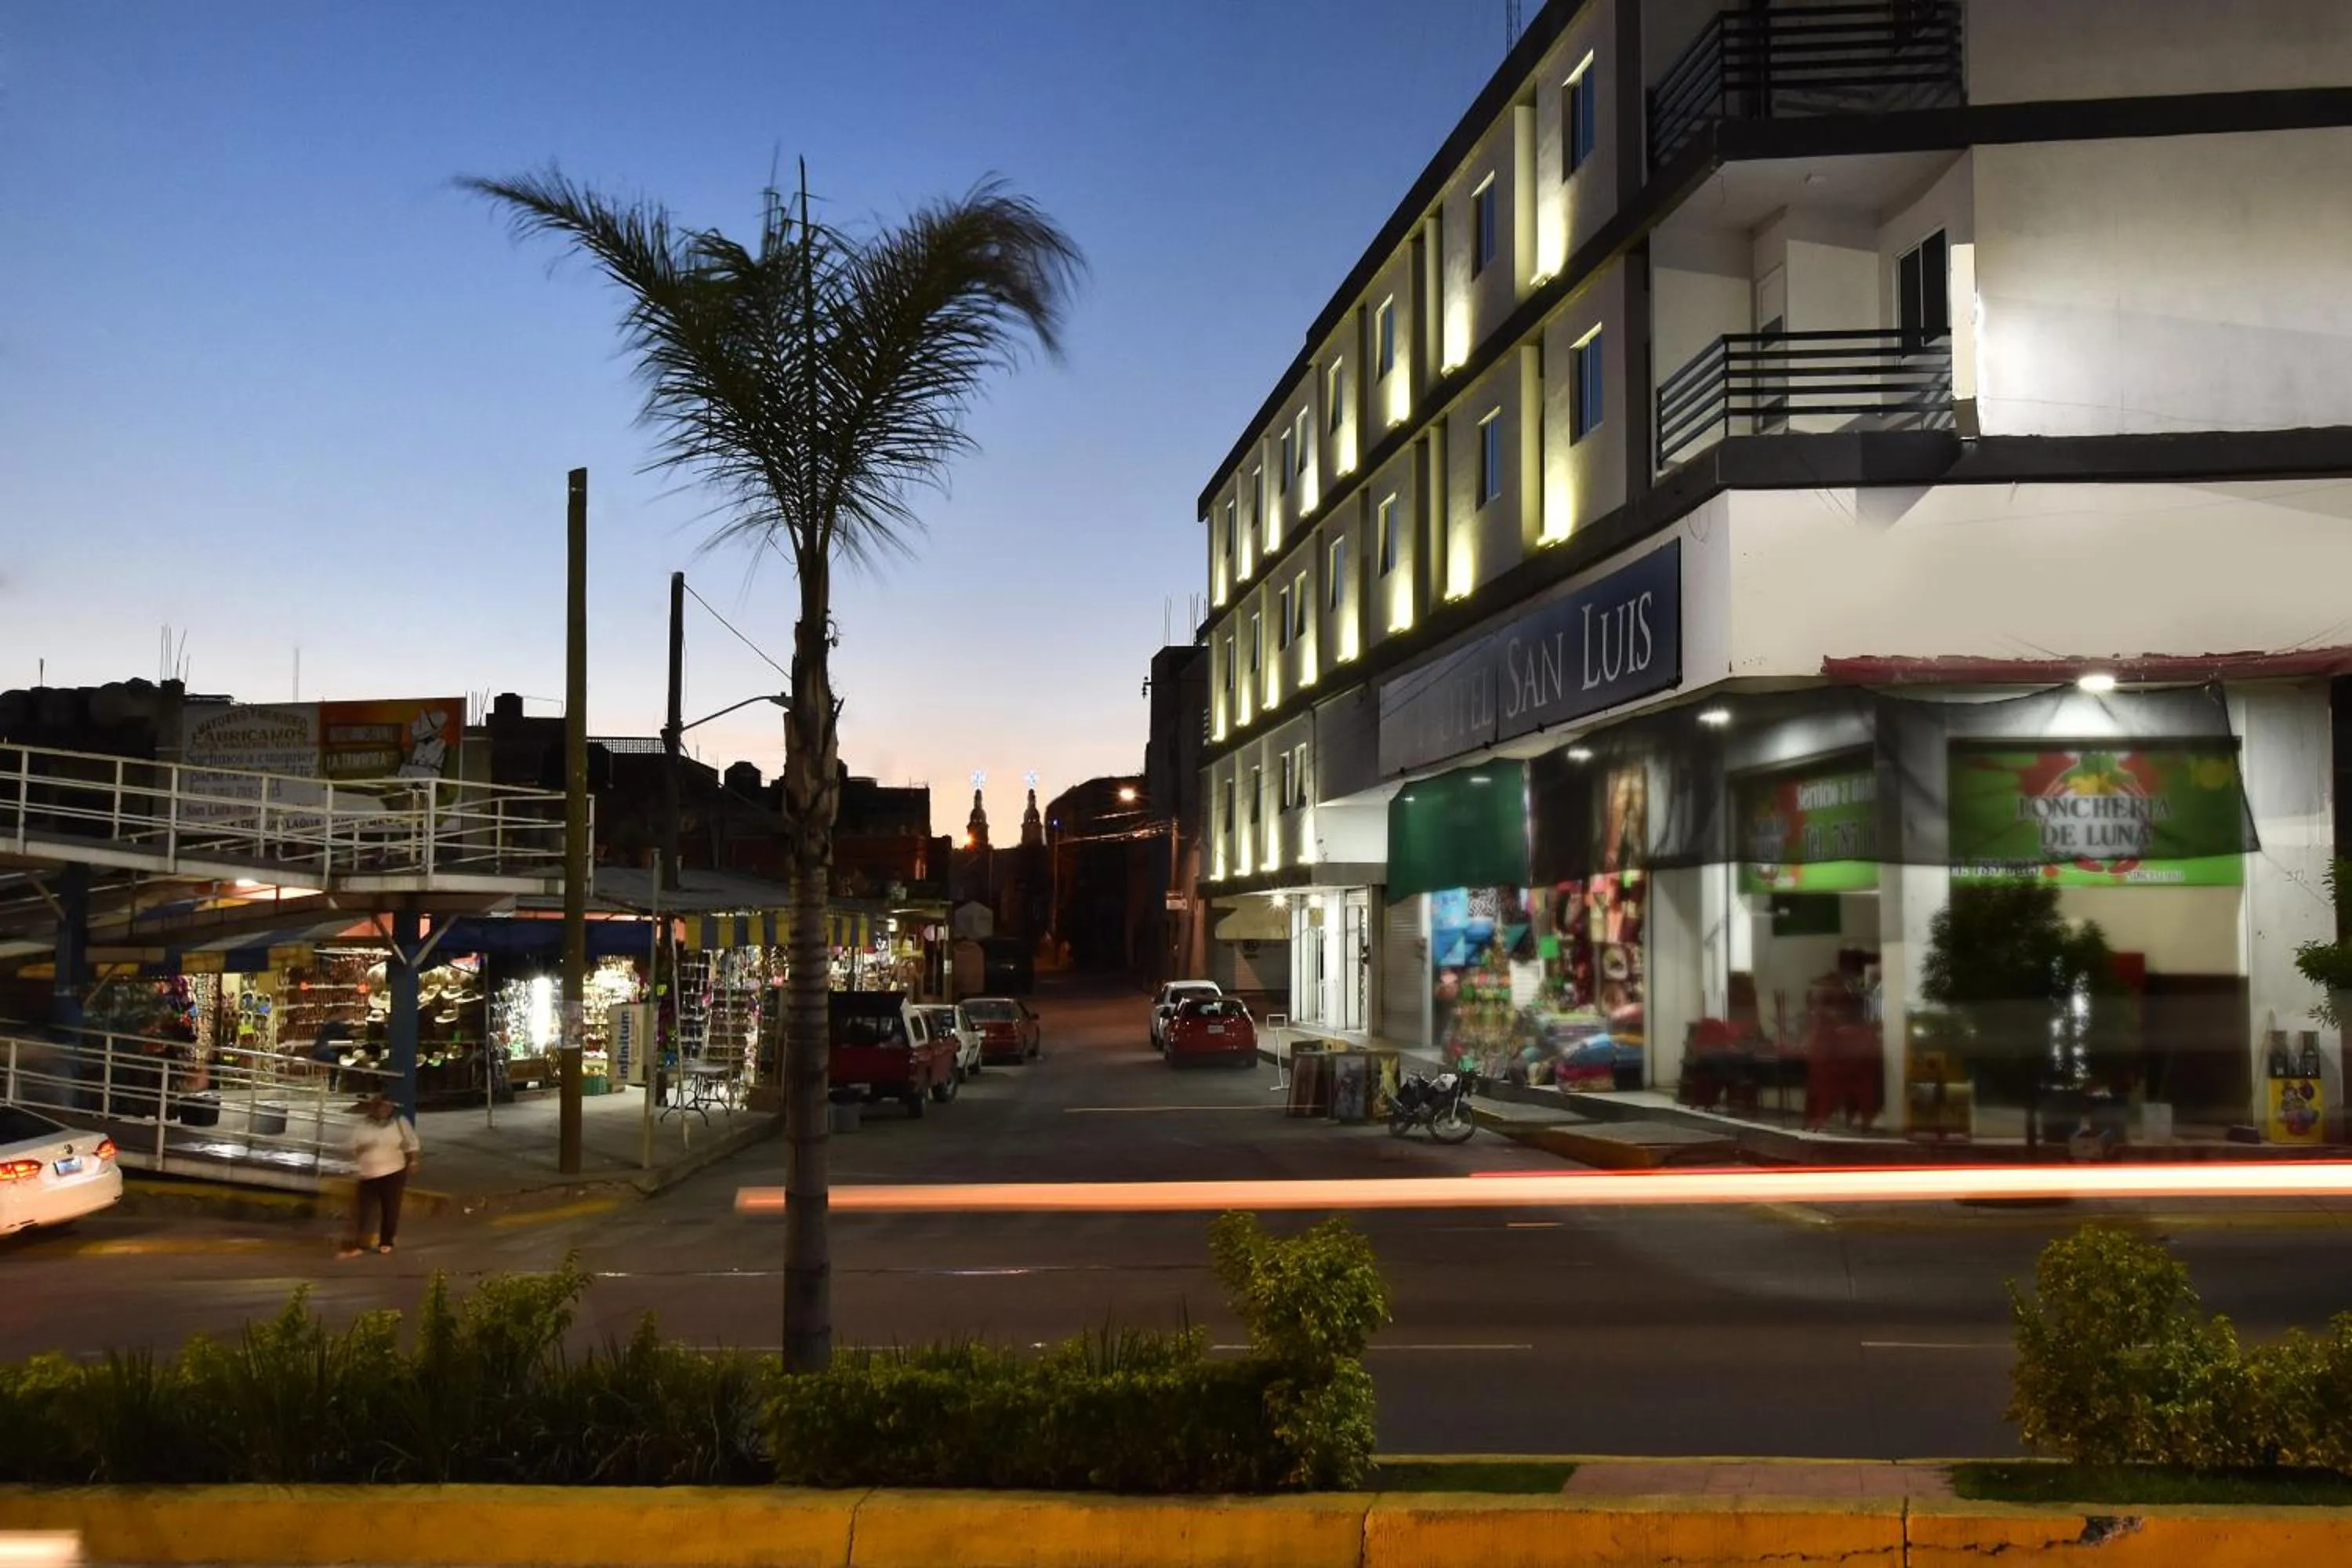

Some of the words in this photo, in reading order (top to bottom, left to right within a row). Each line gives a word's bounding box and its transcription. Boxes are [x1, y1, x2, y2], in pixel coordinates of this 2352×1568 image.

[1506, 633, 1564, 719] SAN
[1581, 590, 1653, 691] LUIS
[2041, 826, 2077, 846] DE
[2086, 824, 2151, 847] LUNA
